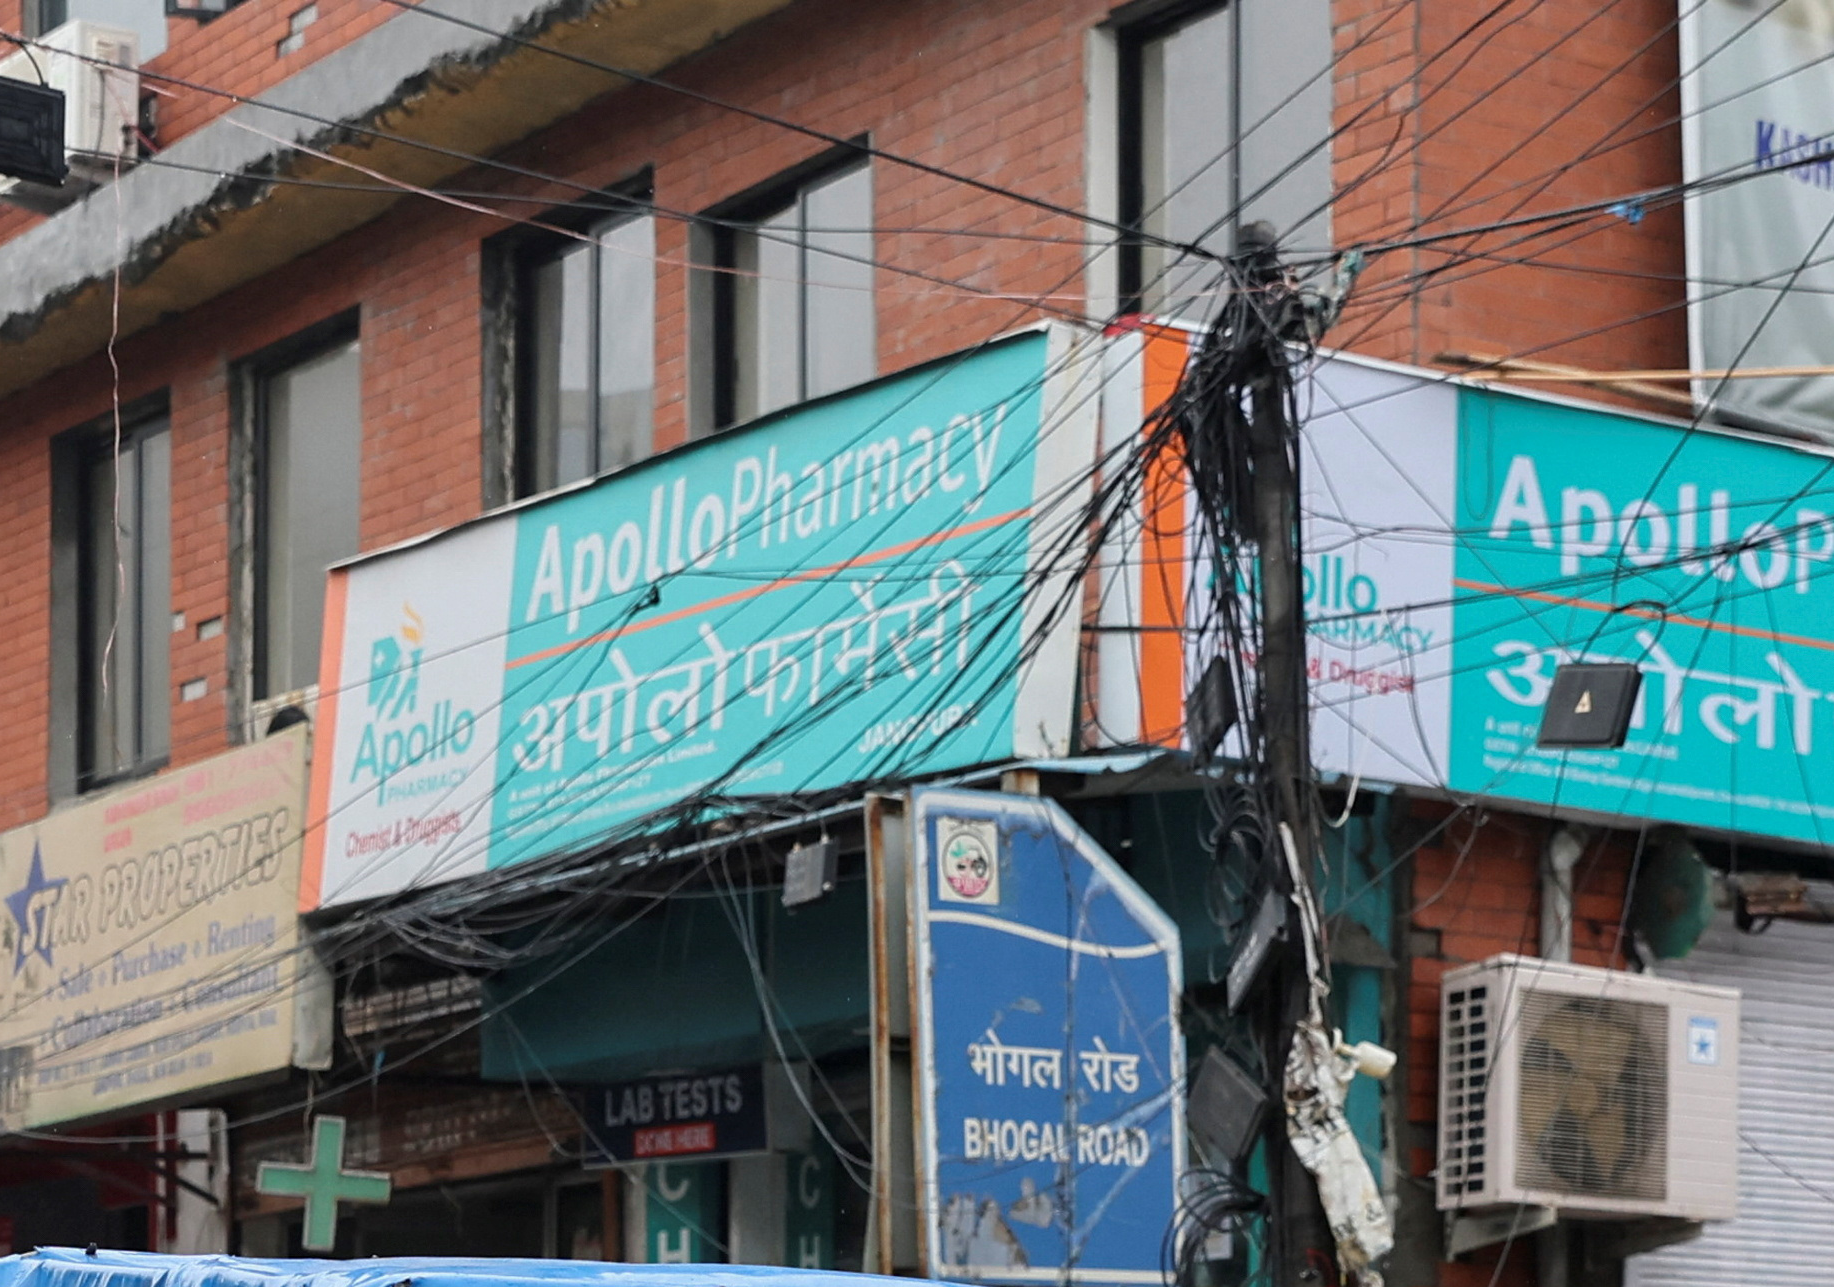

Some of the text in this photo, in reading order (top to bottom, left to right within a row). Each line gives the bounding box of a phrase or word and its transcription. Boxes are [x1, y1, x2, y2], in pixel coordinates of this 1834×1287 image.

[1303, 611, 1433, 653] ARMACY
[348, 698, 476, 806] Apollo
[21, 806, 289, 957] STAR PROPERTIES
[968, 1027, 1140, 1094] भोगल रोड
[604, 1072, 744, 1128] LAB TESTS
[963, 1116, 1149, 1168] BHOGAL ROAD
